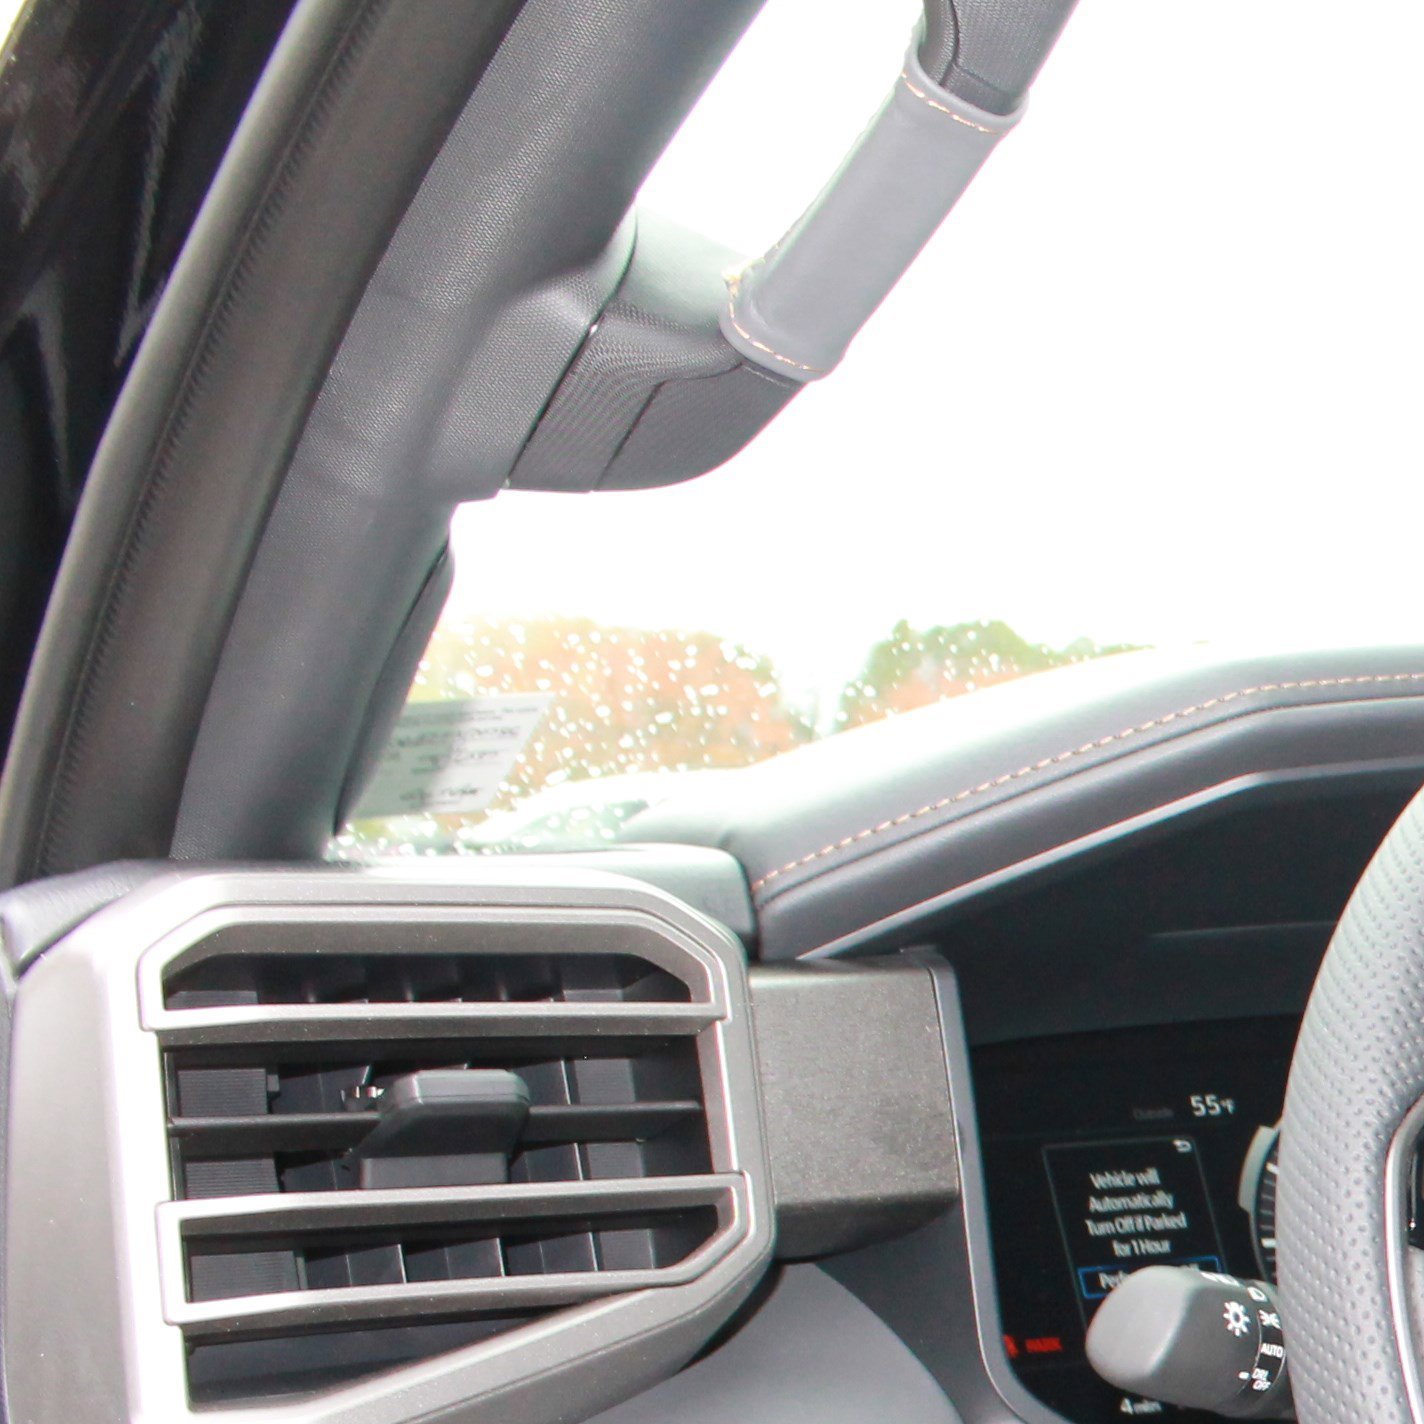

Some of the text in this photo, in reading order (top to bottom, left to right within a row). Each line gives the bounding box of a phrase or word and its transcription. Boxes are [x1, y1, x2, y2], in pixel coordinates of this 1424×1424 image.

[1089, 1167, 1160, 1189] Vehicle will
[1089, 1190, 1174, 1212] Automatically
[1084, 1219, 1115, 1235] Turn
[1115, 1215, 1135, 1233] Off
[1143, 1211, 1187, 1231] Parked
[1112, 1240, 1131, 1256] for
[1139, 1239, 1171, 1254] Hour
[1260, 1343, 1284, 1358] AUTO
[1252, 1380, 1271, 1391] OFF
